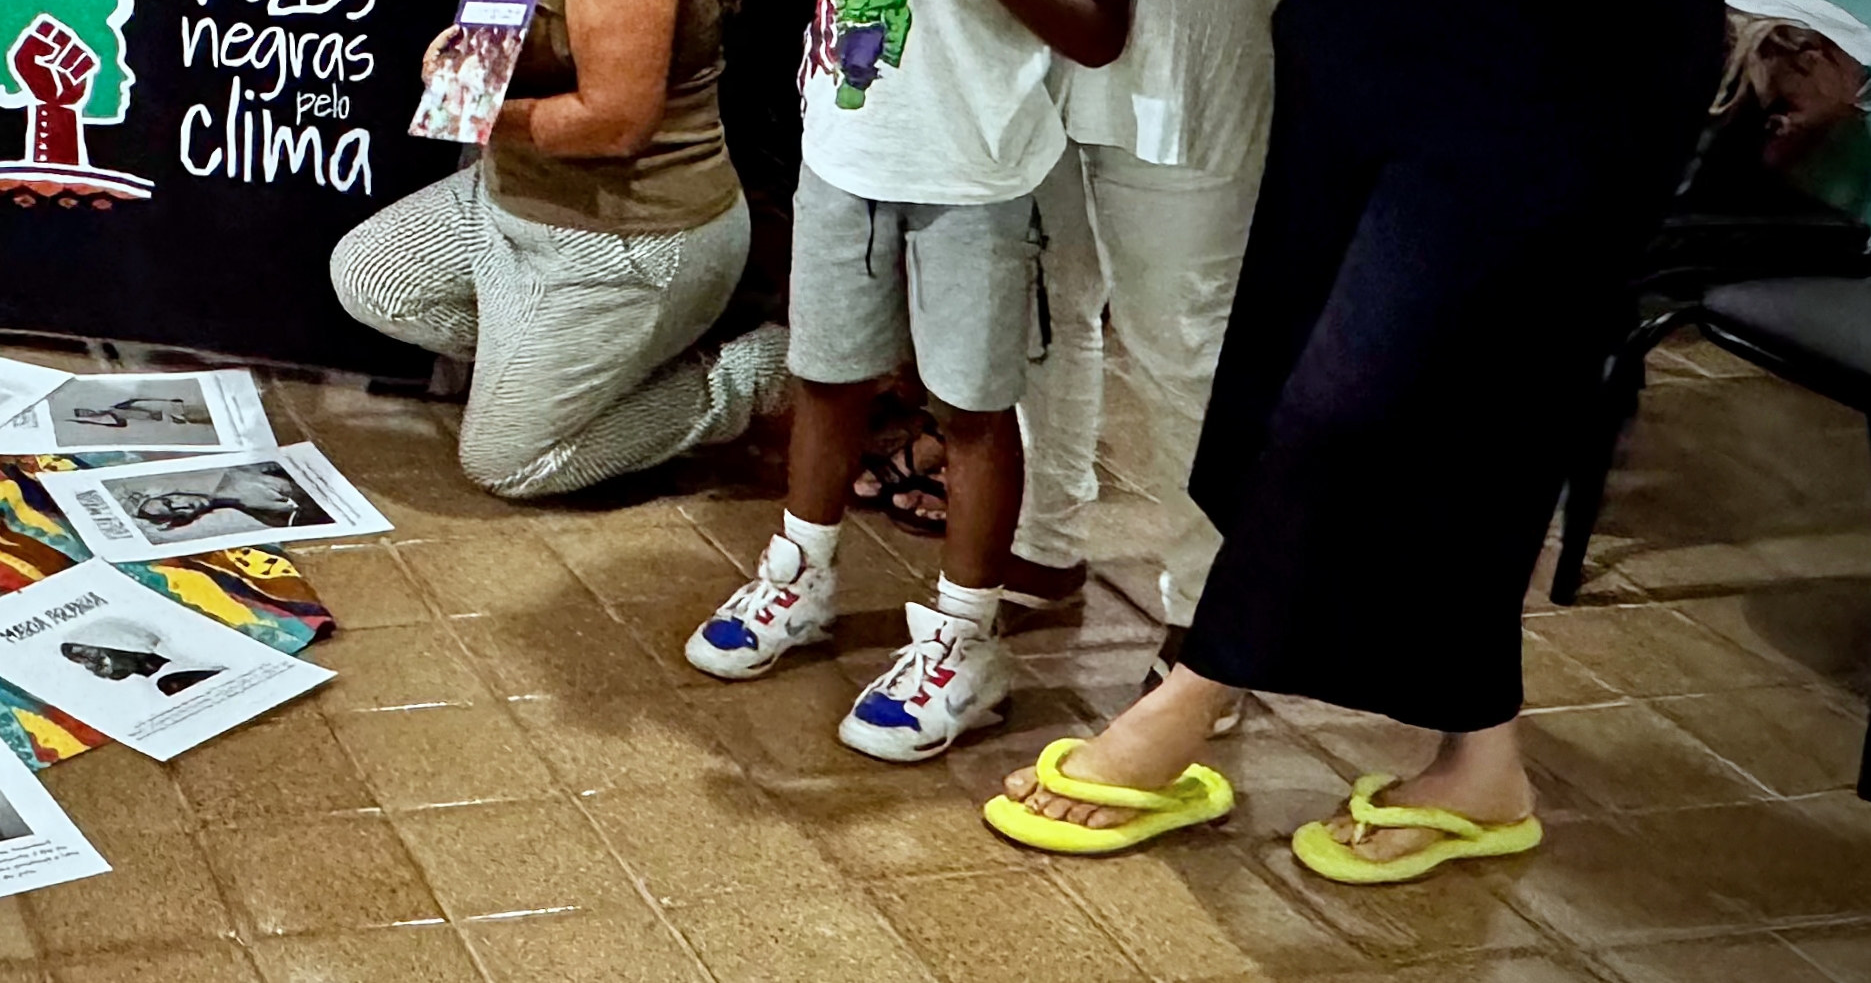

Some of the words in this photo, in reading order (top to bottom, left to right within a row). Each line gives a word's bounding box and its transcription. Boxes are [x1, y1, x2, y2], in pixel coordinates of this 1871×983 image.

[181, 15, 374, 101] negras
[180, 76, 373, 196] clima
[296, 83, 350, 125] pelo
